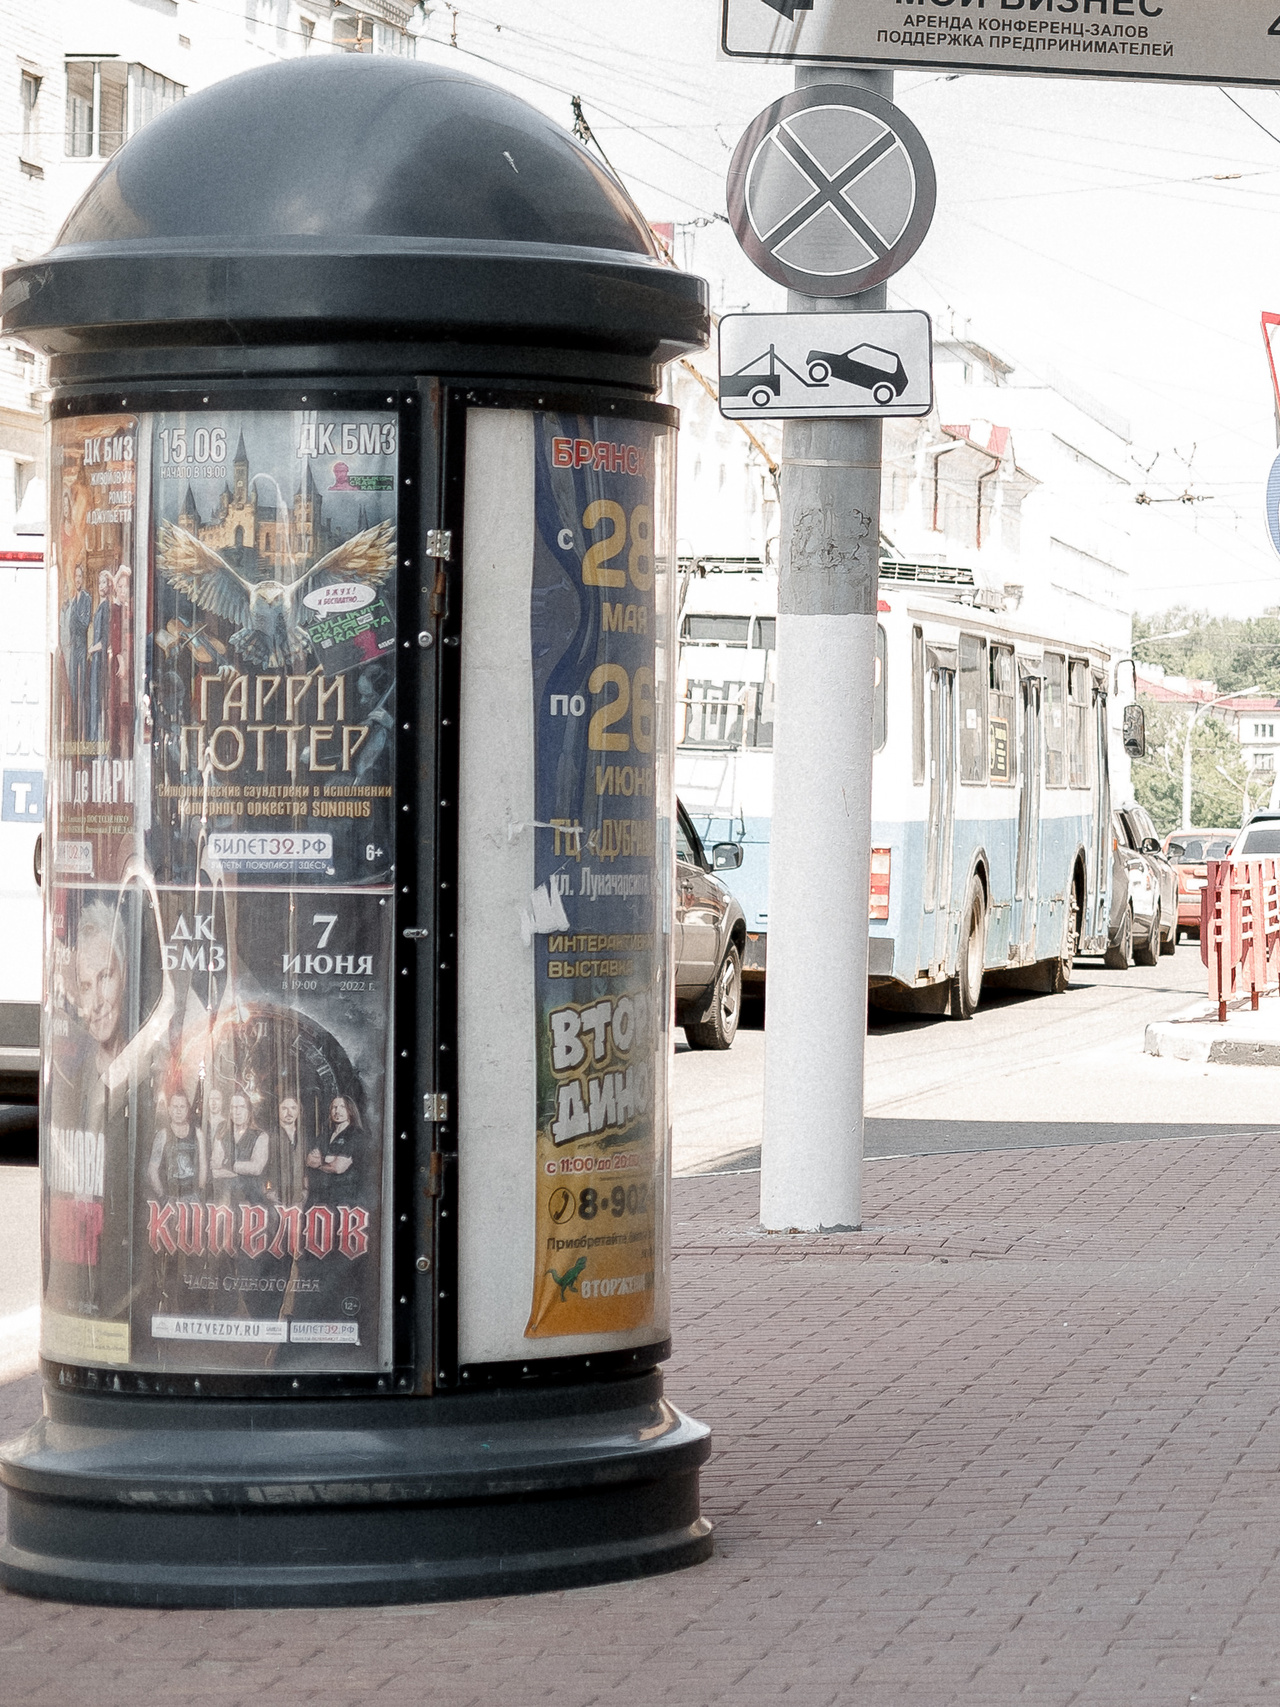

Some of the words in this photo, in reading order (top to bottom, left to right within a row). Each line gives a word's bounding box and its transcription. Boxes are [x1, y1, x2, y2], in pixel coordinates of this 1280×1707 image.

[903, 14, 973, 31] АРЕНДА
[978, 18, 1148, 38] КОНФЕРЕНЦ-ЗАЛОВ
[877, 29, 984, 48] ПОДДЕРЖКА
[989, 35, 1174, 57] ПРЕДПРИНИМАТЕЛЕЙ
[83, 438, 101, 466] ДК
[103, 435, 134, 463] БМЗ
[159, 428, 227, 464] 15.06
[296, 423, 336, 458] ДК
[341, 423, 396, 456] БМЗ
[160, 466, 192, 479] НАЧАЛО
[194, 466, 200, 479] В
[203, 466, 227, 479] 19:00
[582, 499, 652, 592] 28
[602, 602, 649, 635] МАЯ
[199, 674, 346, 721] ГАРРИ
[588, 663, 653, 754] 26
[180, 724, 370, 771] ПОТТЕР
[92, 759, 134, 804] ПАРИ
[243, 785, 310, 799] саундтреки
[313, 785, 320, 797] в
[323, 785, 392, 797] исполнении
[247, 801, 307, 816] оркестра
[312, 801, 371, 818] SONORUS
[213, 838, 327, 856] БИЛЕТ32.РФ
[366, 844, 383, 861] 6+
[245, 860, 294, 871] ПОКУПАЮТ
[299, 860, 327, 871] ЗДЕСЬ
[171, 913, 216, 941] ДК
[313, 914, 338, 949] 7
[161, 945, 226, 972] БМЗ
[282, 954, 373, 976] ИЮНЯ
[547, 960, 633, 979] ВЫСТАВКА
[291, 980, 317, 991] 19:00
[340, 981, 365, 991] 2022
[560, 1157, 594, 1173] 11:00
[597, 1158, 611, 1171] до
[547, 1231, 627, 1252] Приобретайте
[183, 1274, 219, 1290] ЧАСЫ
[223, 1275, 286, 1292] СУДНОГО
[290, 1278, 320, 1292] ДНЯ
[345, 1301, 358, 1311] 12+
[175, 1321, 260, 1337] ARTZVEZDY.RU
[293, 1324, 355, 1334] БИЛЕТ32.РФ
